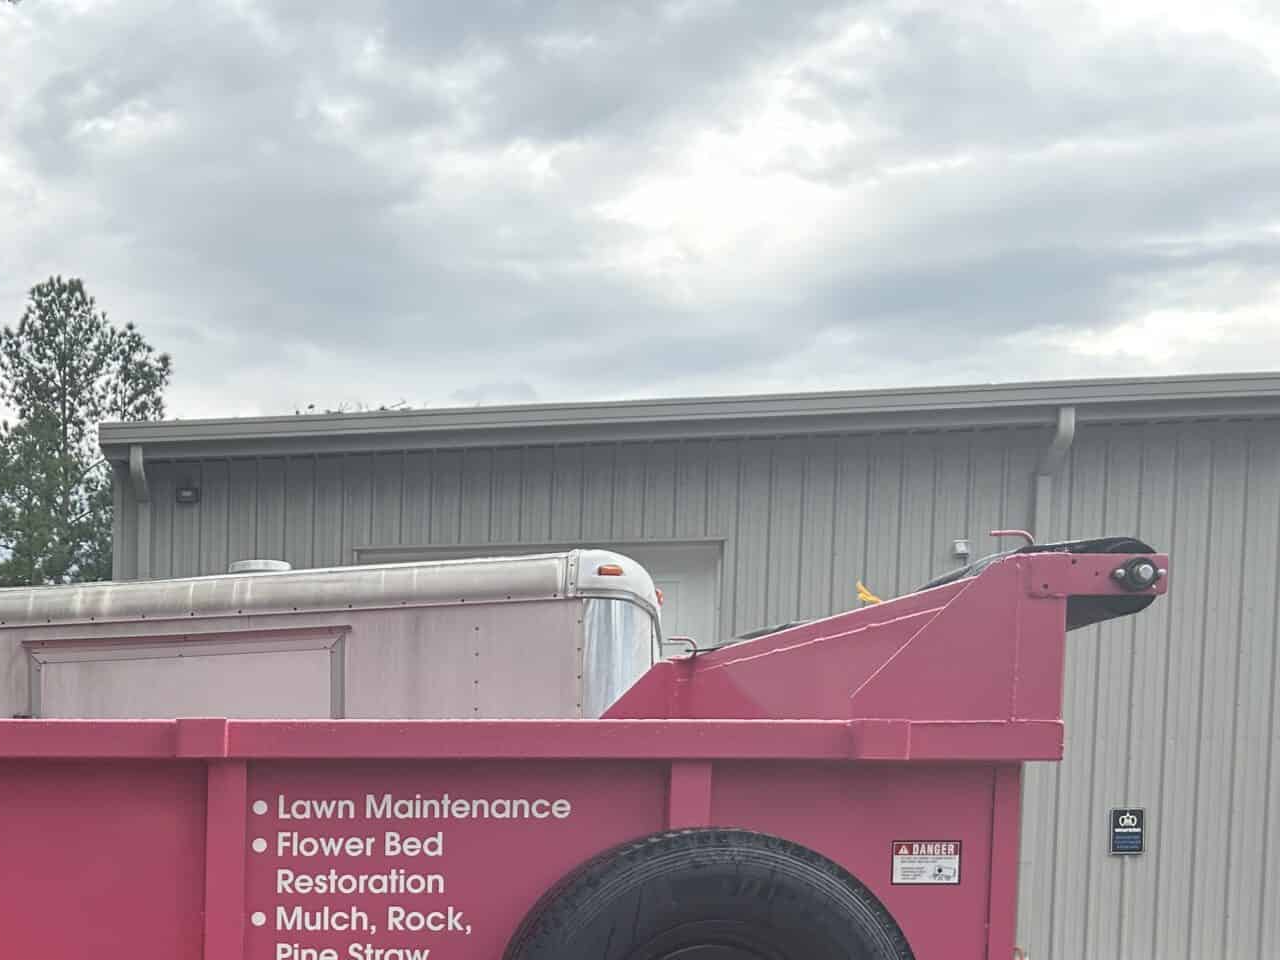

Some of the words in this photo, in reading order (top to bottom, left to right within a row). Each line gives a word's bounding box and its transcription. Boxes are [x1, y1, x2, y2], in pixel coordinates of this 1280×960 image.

[277, 794, 355, 819] Lawn
[365, 793, 572, 819] Maintenance
[276, 831, 375, 857] Flower
[384, 831, 444, 857] Bed
[912, 844, 954, 855] DANGER
[276, 868, 445, 894] Restoration
[275, 906, 377, 935] Mulch,
[387, 906, 472, 934] Rock,
